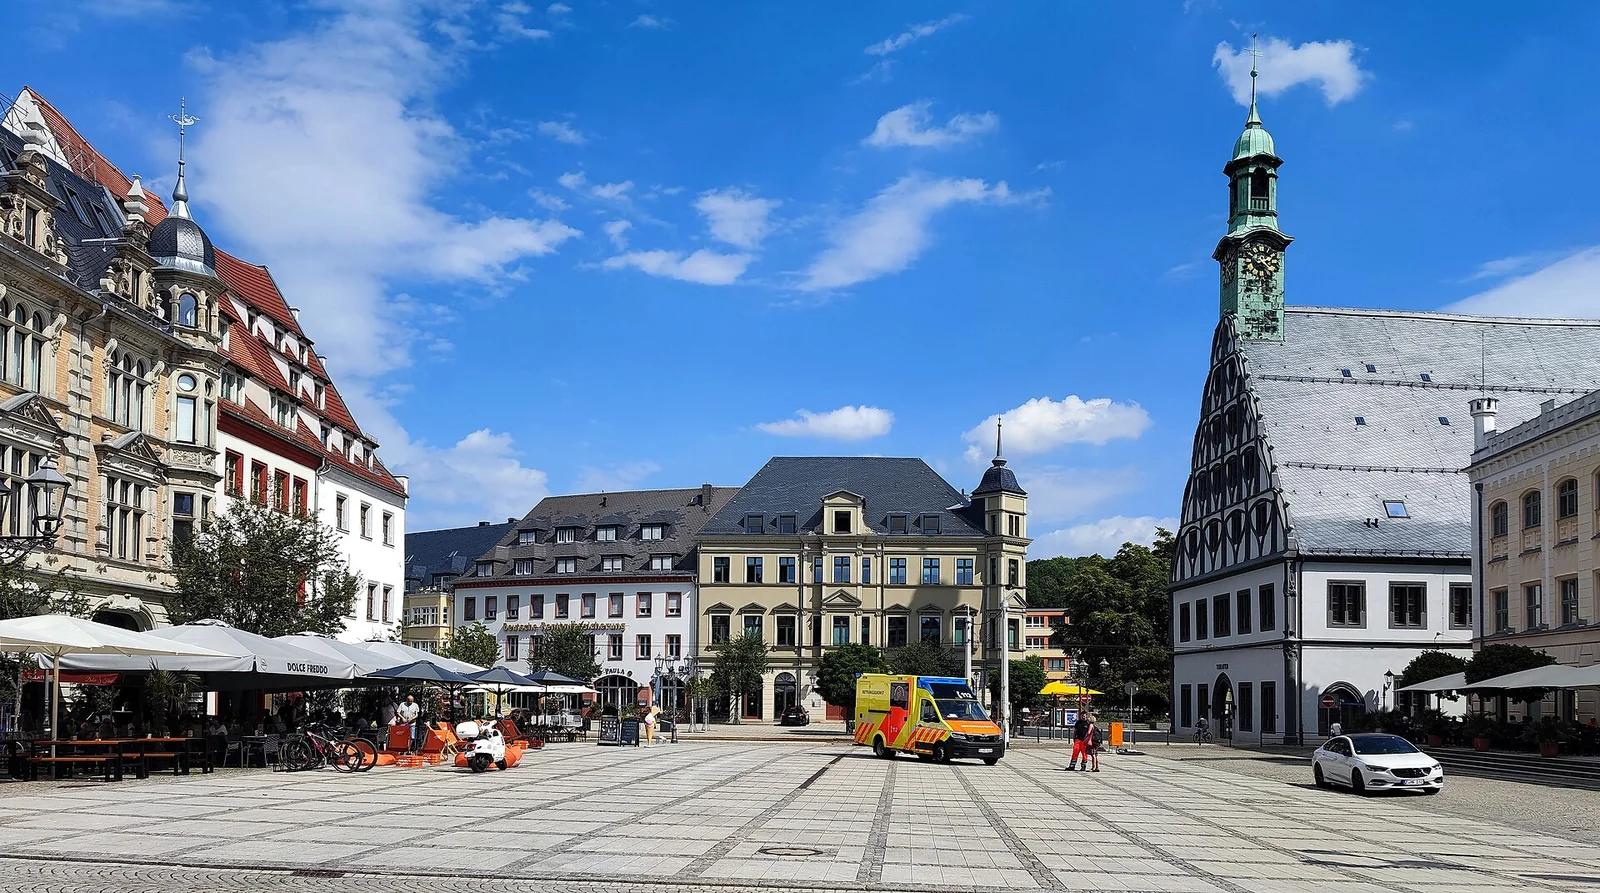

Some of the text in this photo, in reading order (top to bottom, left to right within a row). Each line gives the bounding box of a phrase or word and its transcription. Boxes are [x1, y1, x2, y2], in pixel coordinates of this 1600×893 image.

[287, 662, 328, 674] DOLCE FREDDO
[604, 667, 625, 675] PAULA
